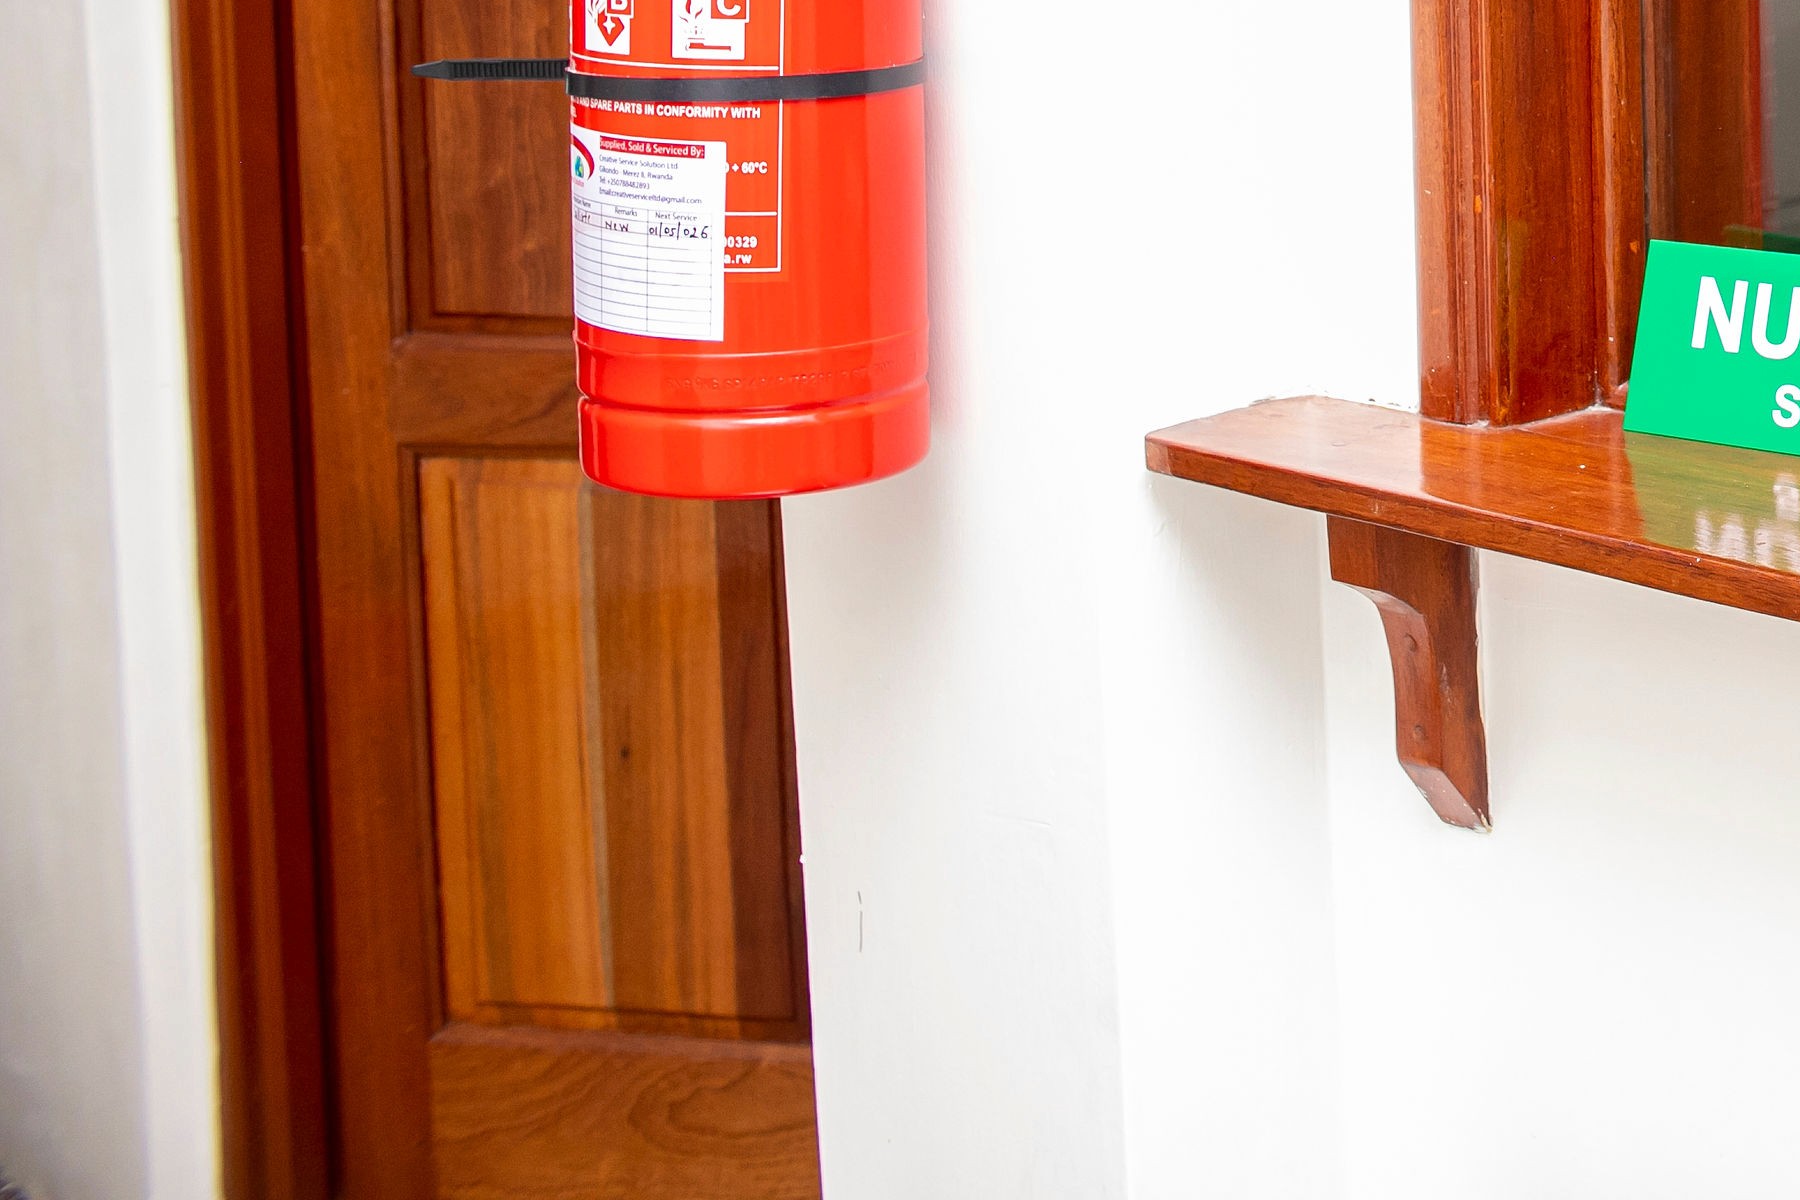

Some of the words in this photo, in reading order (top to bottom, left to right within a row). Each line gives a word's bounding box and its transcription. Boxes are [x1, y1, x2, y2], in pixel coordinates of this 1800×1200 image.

[591, 98, 612, 111] SPARE
[614, 101, 642, 115] PARTS
[644, 103, 654, 115] IN
[656, 104, 729, 118] CONFORMITY
[731, 106, 761, 119] WITH
[628, 141, 644, 153] Sold
[645, 143, 651, 153] &
[653, 143, 688, 155] Serviced
[690, 146, 704, 158] By:
[639, 159, 665, 169] Solution
[667, 162, 679, 170] Ltd
[615, 206, 638, 217] Remarks
[655, 211, 671, 219] Next
[673, 212, 698, 221] Service
